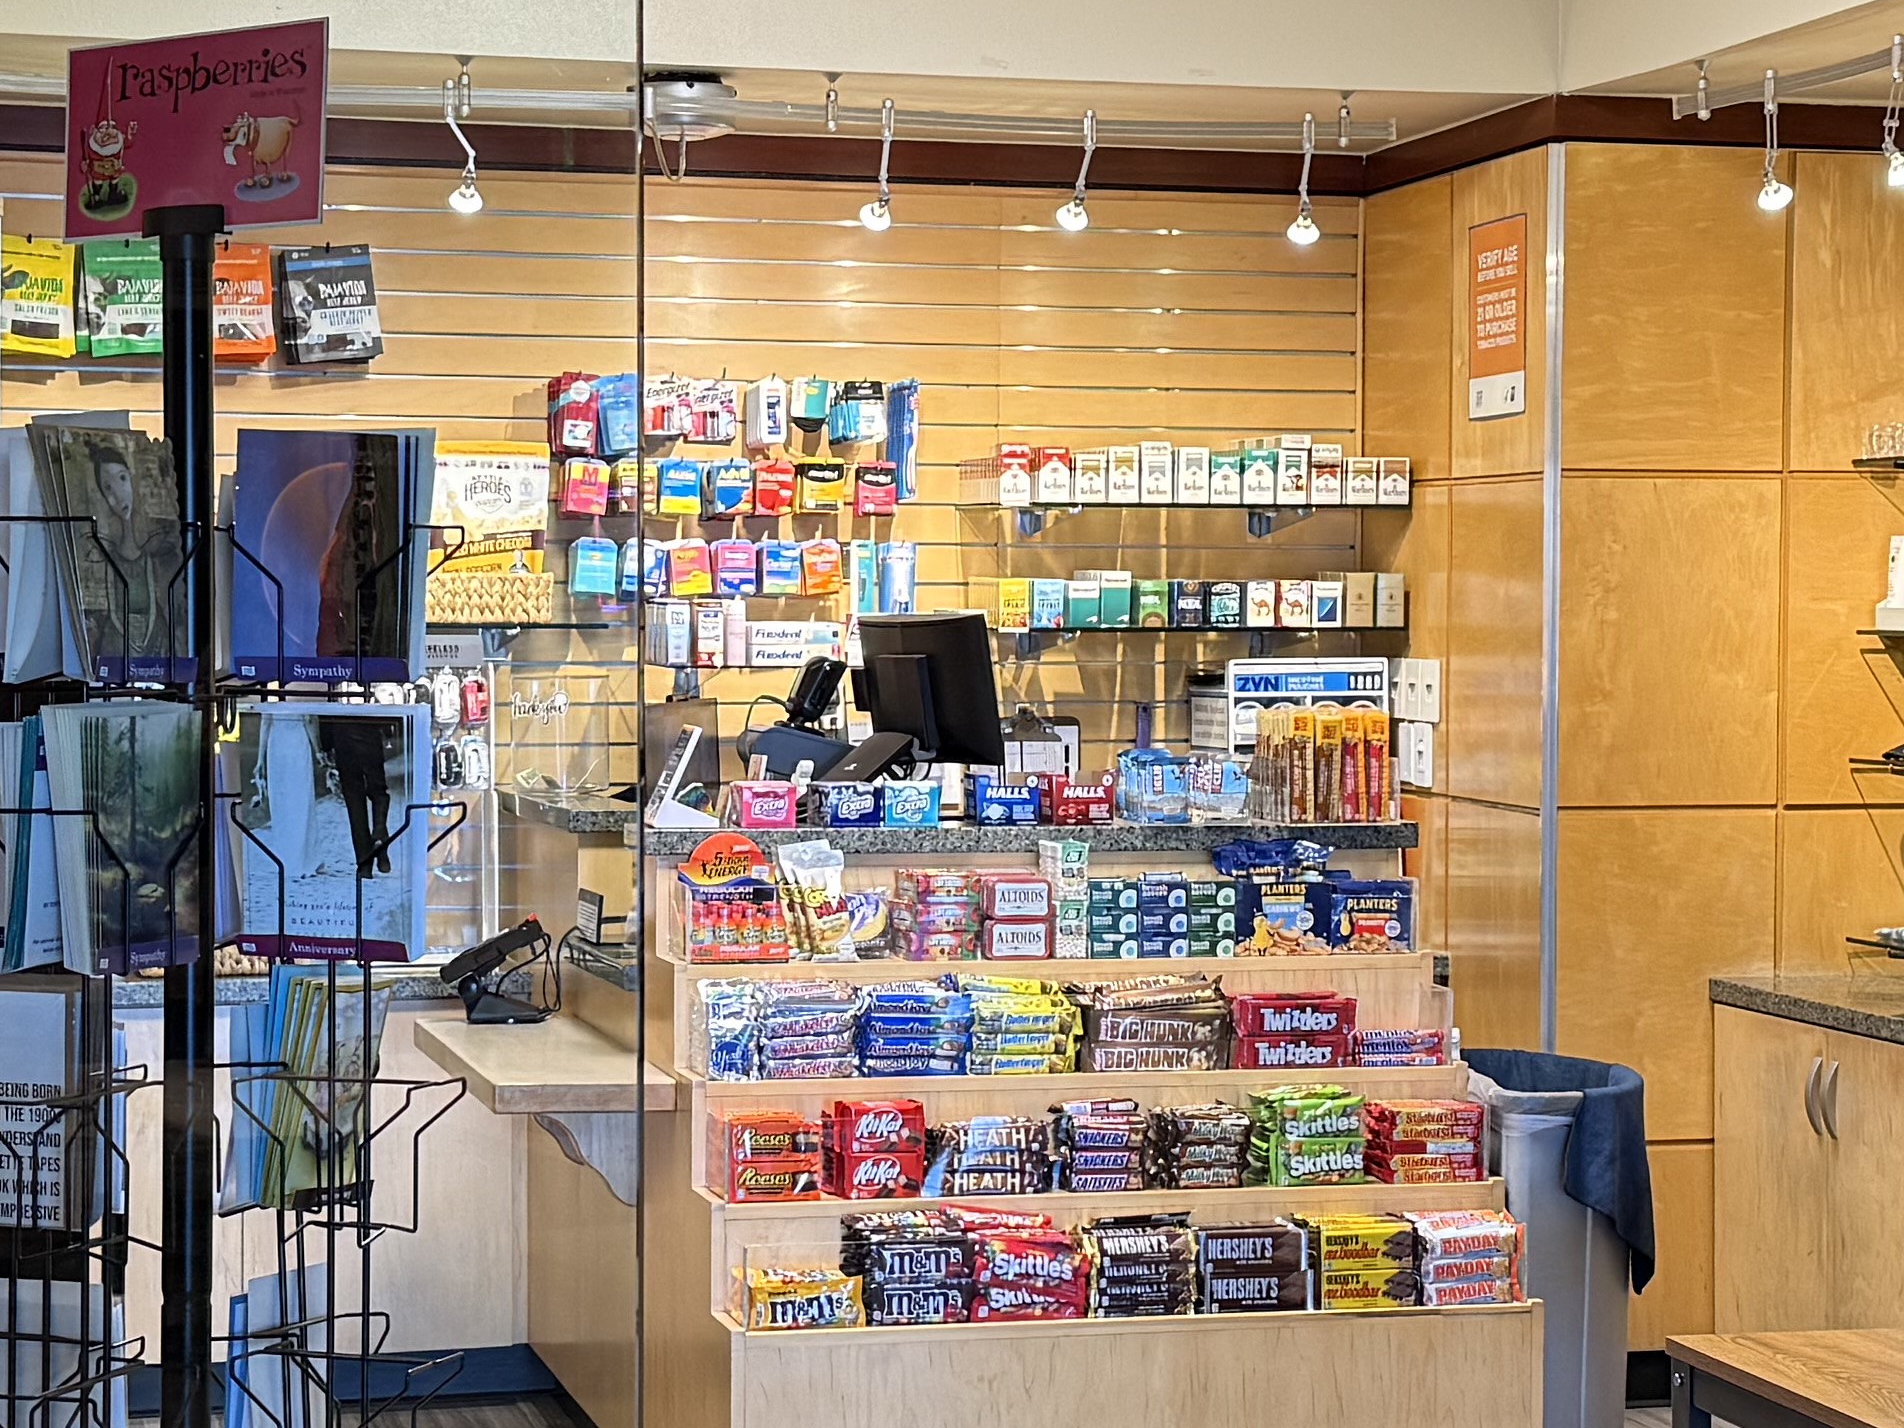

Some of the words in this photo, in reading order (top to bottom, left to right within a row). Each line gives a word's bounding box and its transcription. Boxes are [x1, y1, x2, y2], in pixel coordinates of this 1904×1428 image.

[116, 48, 308, 113] raspberries
[293, 663, 352, 679] Sympathy
[1237, 676, 1280, 692] ZYN
[986, 786, 1029, 799] HALLS
[1063, 786, 1105, 799] HALLS
[754, 800, 787, 813] Extra
[841, 800, 872, 813] Extra
[896, 799, 928, 813] Extra
[998, 889, 1045, 904] ALTOIDS
[1261, 884, 1307, 896] PLANTERS
[1347, 899, 1398, 911] PLANTERS
[292, 917, 355, 927] BEAUTIFU
[996, 930, 1042, 945] ALTOIDS
[129, 949, 167, 966] Sympathy
[289, 942, 356, 957] Anniversary
[1260, 1007, 1338, 1032] Twizzlers
[1108, 1018, 1141, 1041] BIG
[1143, 1019, 1192, 1042] HUNK
[1103, 1048, 1136, 1070] BIG
[1138, 1048, 1188, 1071] HUNK
[1255, 1041, 1332, 1066] Twizzlers
[32, 1084, 61, 1100] BORN
[5, 1106, 25, 1122] THE
[1285, 1114, 1360, 1139] Skittles
[958, 1127, 1026, 1151] HEATH
[1075, 1131, 1128, 1149] SNICKERS
[1074, 1151, 1126, 1169] SNICKERS
[1289, 1151, 1365, 1177] Skittles
[50, 1181, 60, 1197] IS
[954, 1172, 1020, 1194] HEATH
[1102, 1235, 1170, 1255] HERSHEY'S
[1207, 1237, 1273, 1260] HERSHEY'S
[1441, 1234, 1500, 1253] PAYDAY
[993, 1252, 1073, 1281] Skittles
[1433, 1258, 1493, 1280] PAYDAY
[1212, 1277, 1279, 1300] HERSHEY'S
[1436, 1281, 1495, 1304] PAYDAY
